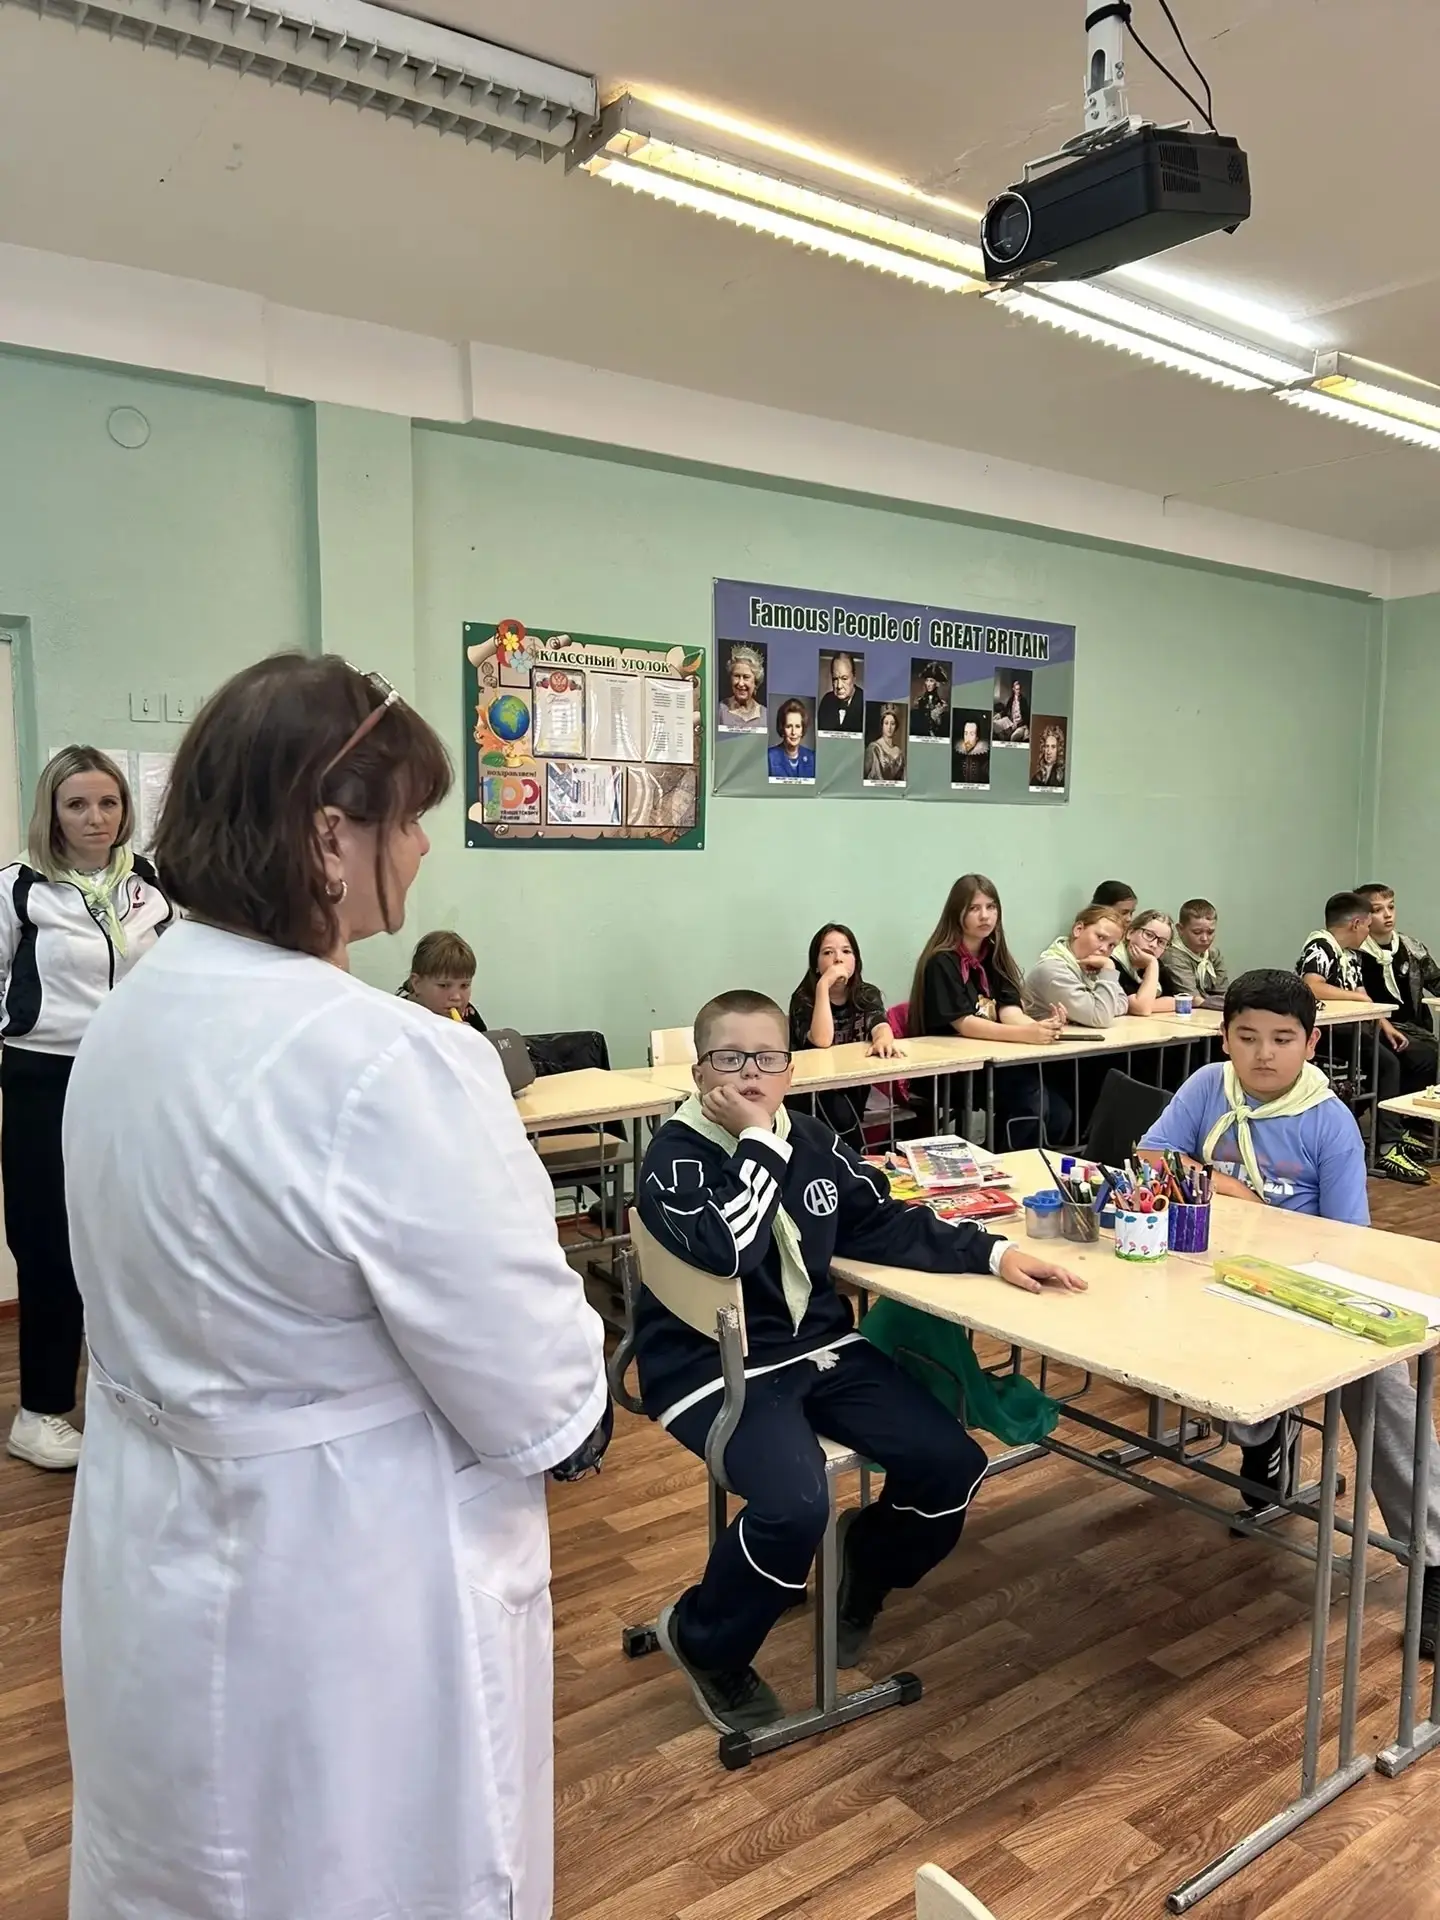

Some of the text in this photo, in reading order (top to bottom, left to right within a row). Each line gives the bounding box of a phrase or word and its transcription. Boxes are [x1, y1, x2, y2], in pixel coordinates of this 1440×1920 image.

[751, 597, 1049, 660] Famous People of GREAT BRITAIN
[540, 650, 670, 673] КЛАССНЫЙ УГОЛОК
